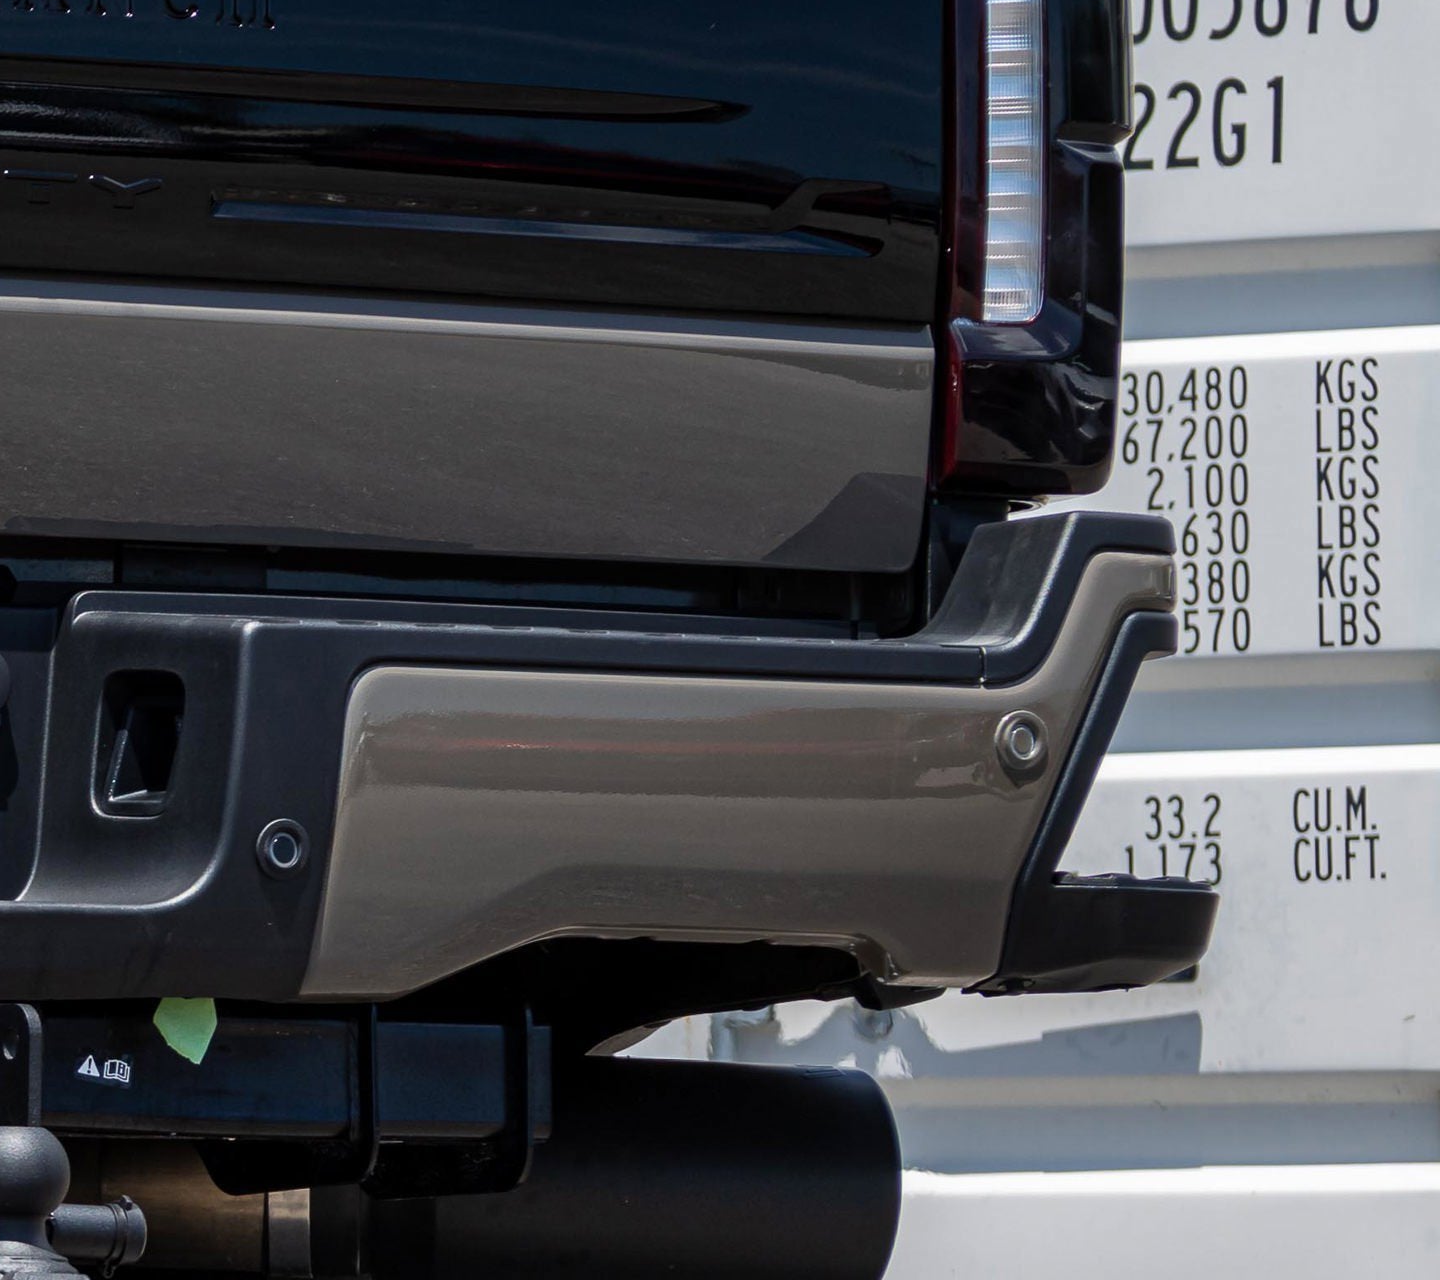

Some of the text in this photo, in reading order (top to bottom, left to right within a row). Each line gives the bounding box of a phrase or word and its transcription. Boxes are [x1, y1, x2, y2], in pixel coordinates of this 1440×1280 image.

[1123, 75, 1285, 170] 22G1
[1122, 358, 1379, 416] 30,480 KGS
[1122, 406, 1380, 465] 67,200 LBS
[1147, 455, 1380, 511] 2,100 KGS
[1318, 503, 1380, 550] LBS
[1318, 552, 1381, 599] KGS
[1318, 601, 1381, 648] LBS
[1145, 793, 1222, 841] 33.2
